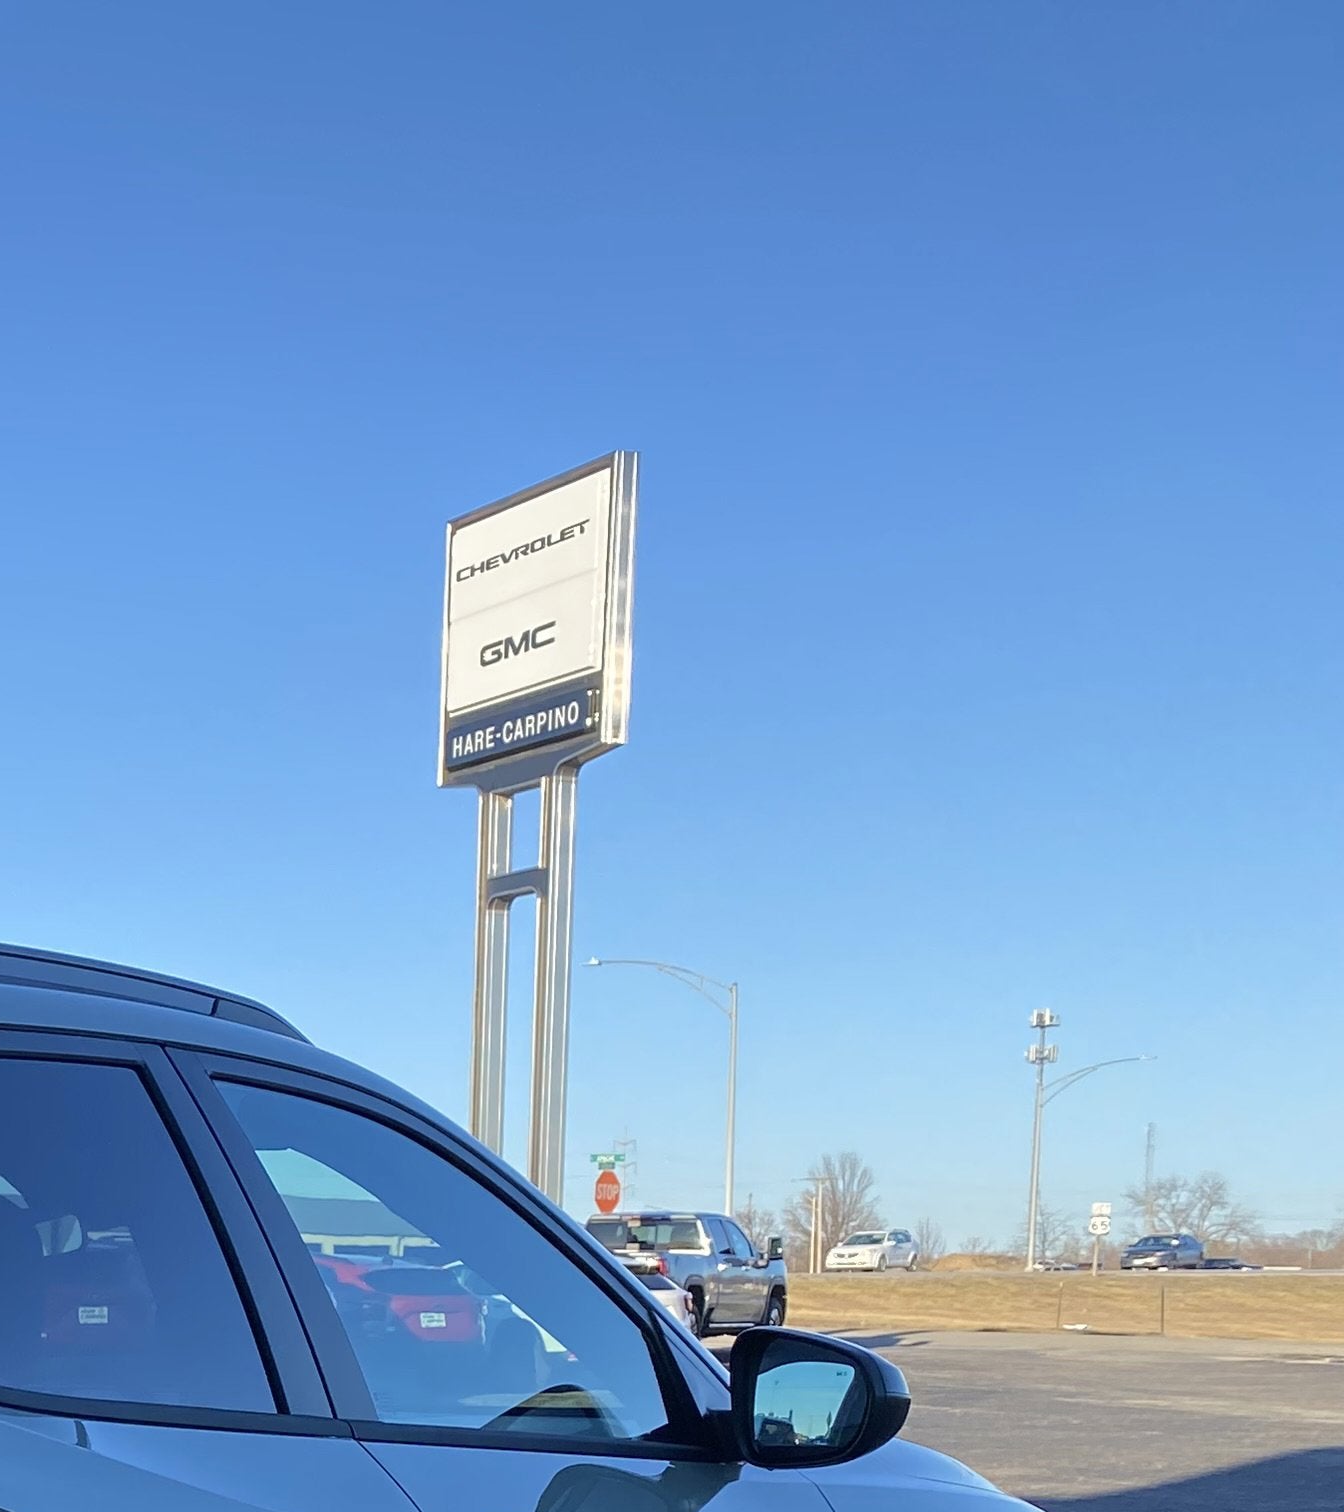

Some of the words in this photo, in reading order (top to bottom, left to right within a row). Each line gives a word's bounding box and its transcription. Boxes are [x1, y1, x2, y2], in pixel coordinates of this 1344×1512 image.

[455, 518, 590, 582] CHEVROLET
[479, 620, 556, 667] GMC
[452, 701, 579, 758] HARE-CARPINO
[597, 1183, 619, 1200] STOP
[1091, 1220, 1108, 1231] 65
